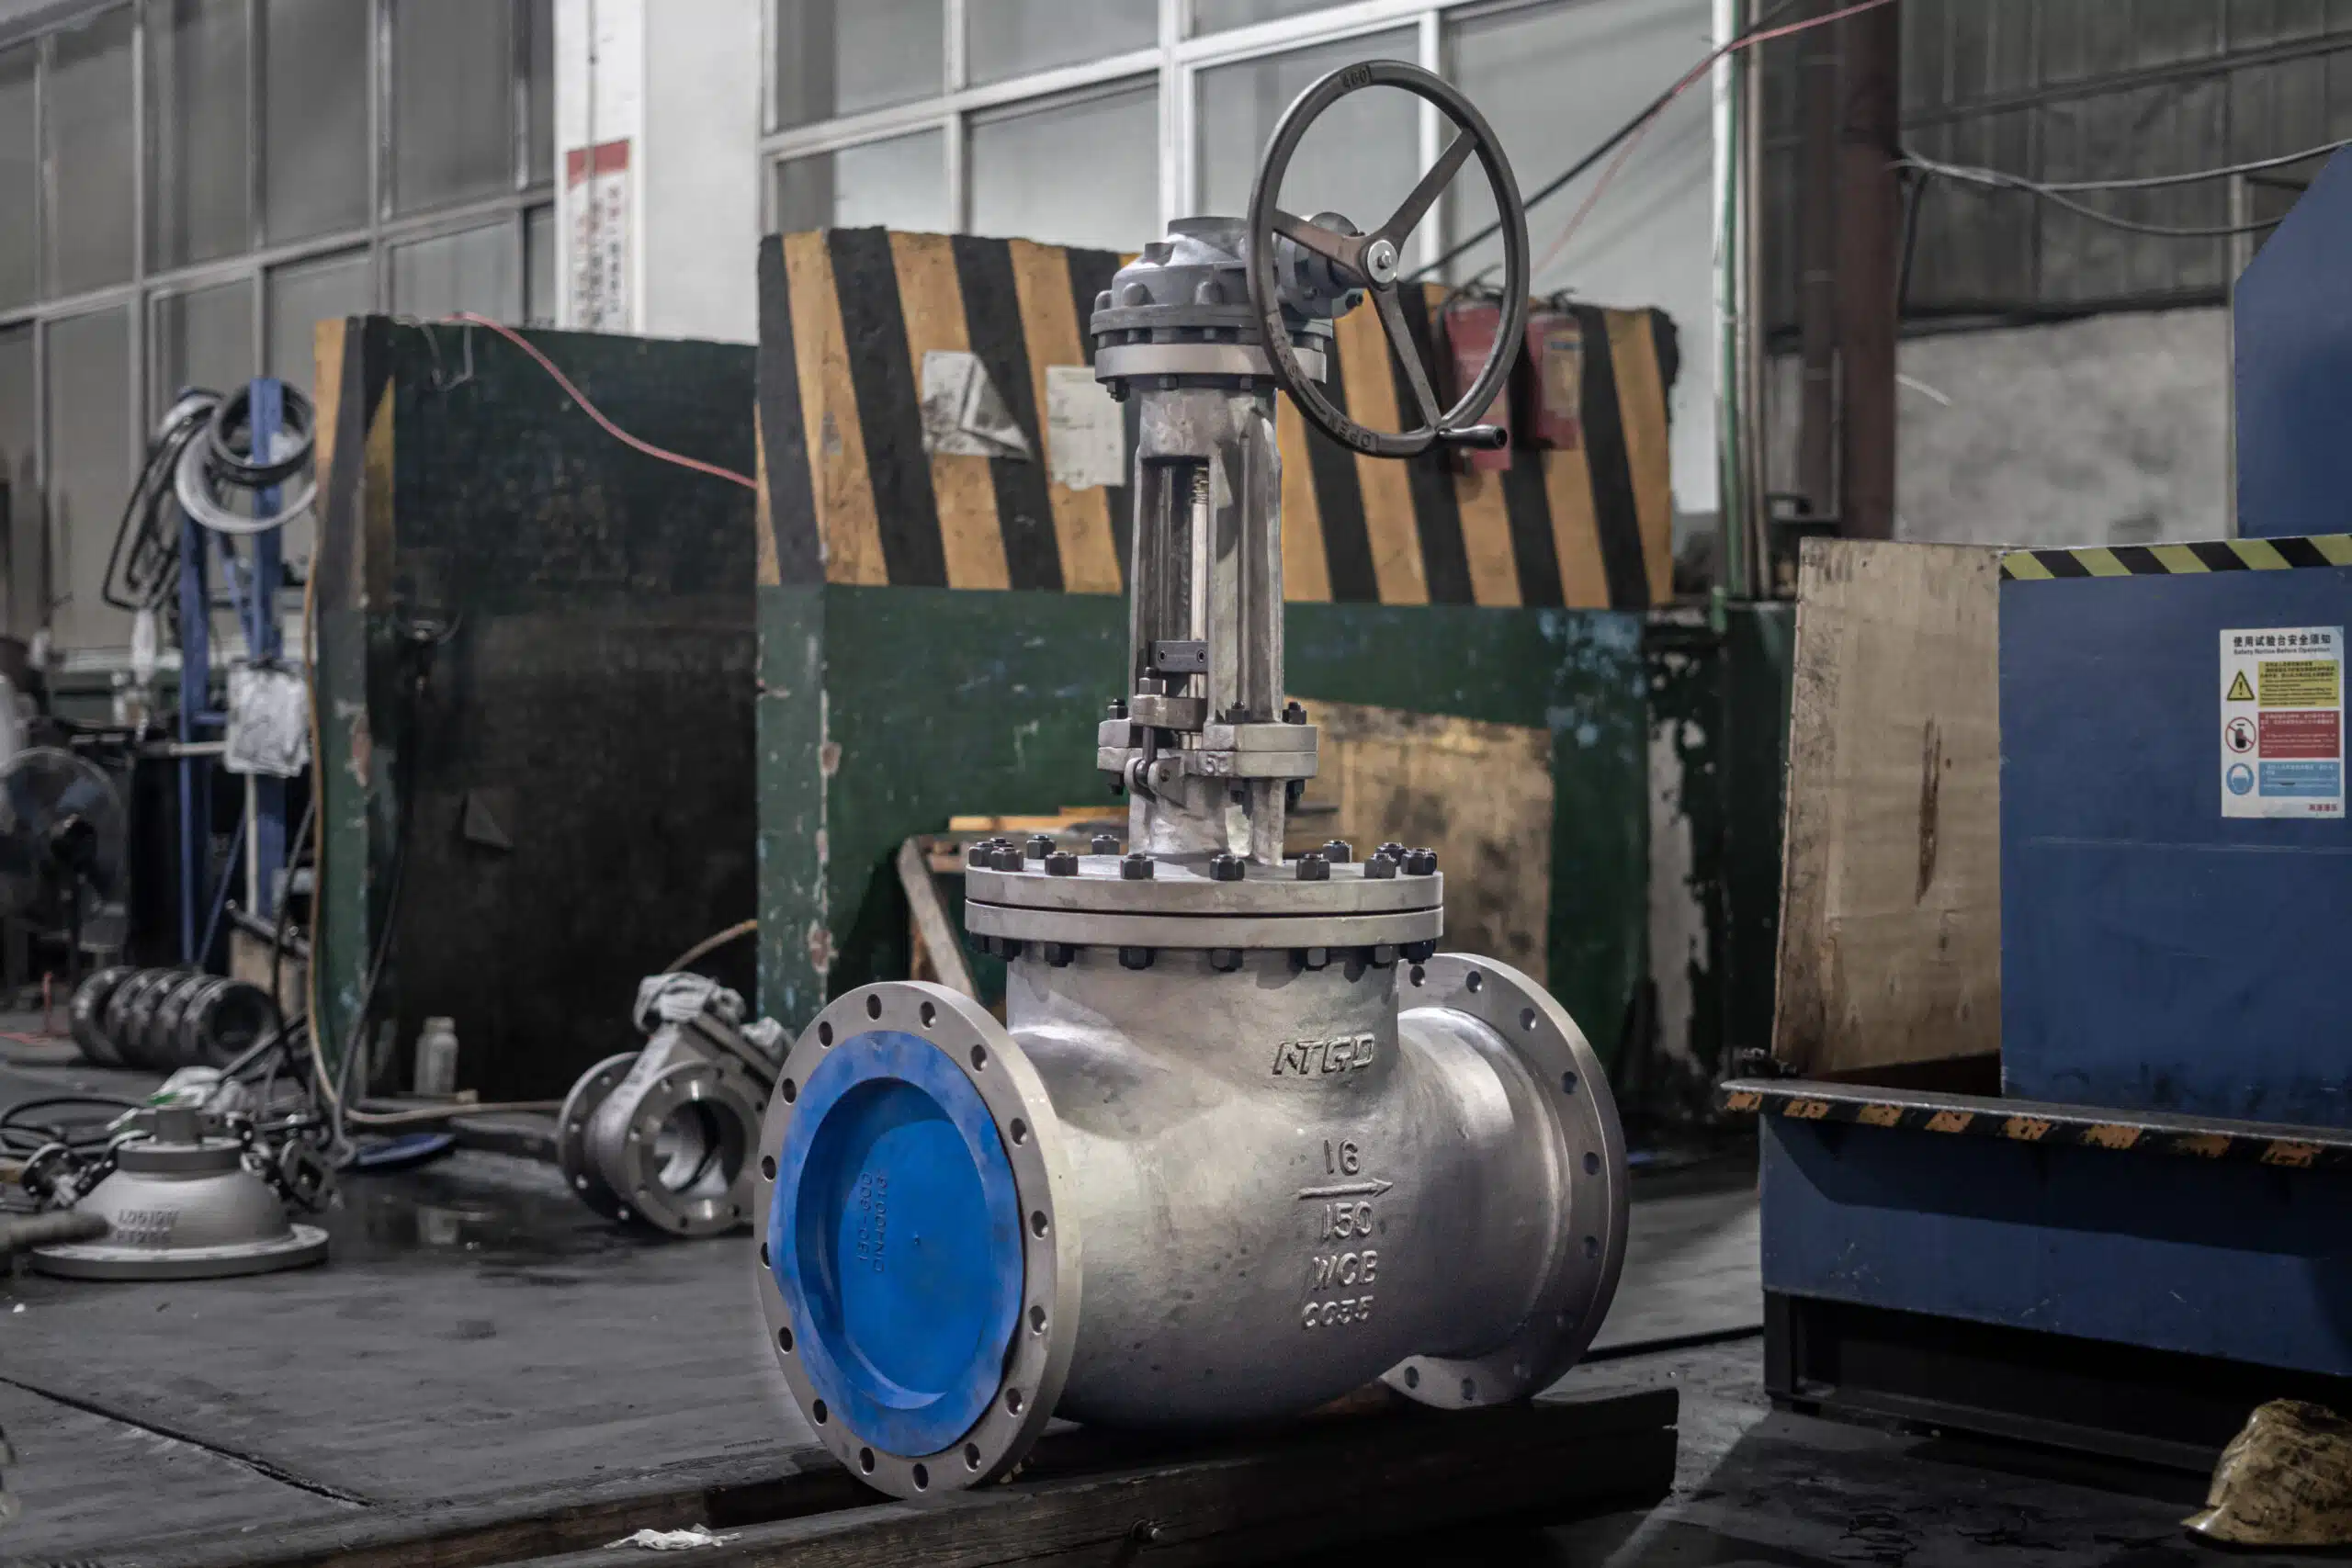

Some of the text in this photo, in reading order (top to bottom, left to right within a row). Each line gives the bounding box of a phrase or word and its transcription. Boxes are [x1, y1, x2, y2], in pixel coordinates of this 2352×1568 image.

[1328, 416, 1372, 448] OPEN
[1323, 1139, 1361, 1177] 16
[1321, 1201, 1373, 1240] 150
[1311, 1250, 1378, 1291] WCB
